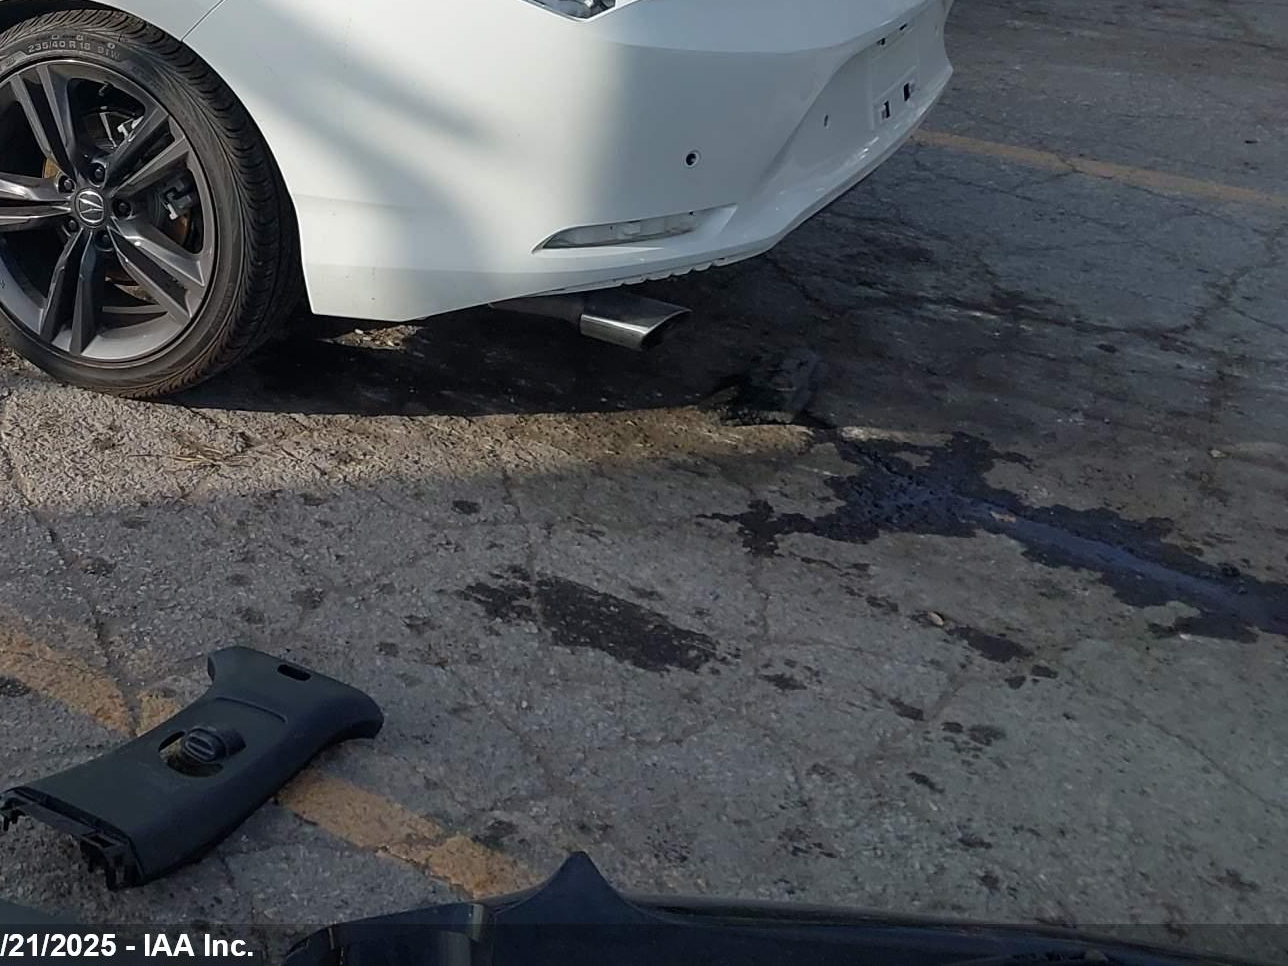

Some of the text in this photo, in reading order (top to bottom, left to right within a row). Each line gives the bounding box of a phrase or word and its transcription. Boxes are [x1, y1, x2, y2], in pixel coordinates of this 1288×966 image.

[28, 40, 66, 53] 235/40
[69, 41, 76, 50] R
[79, 41, 91, 50] 18
